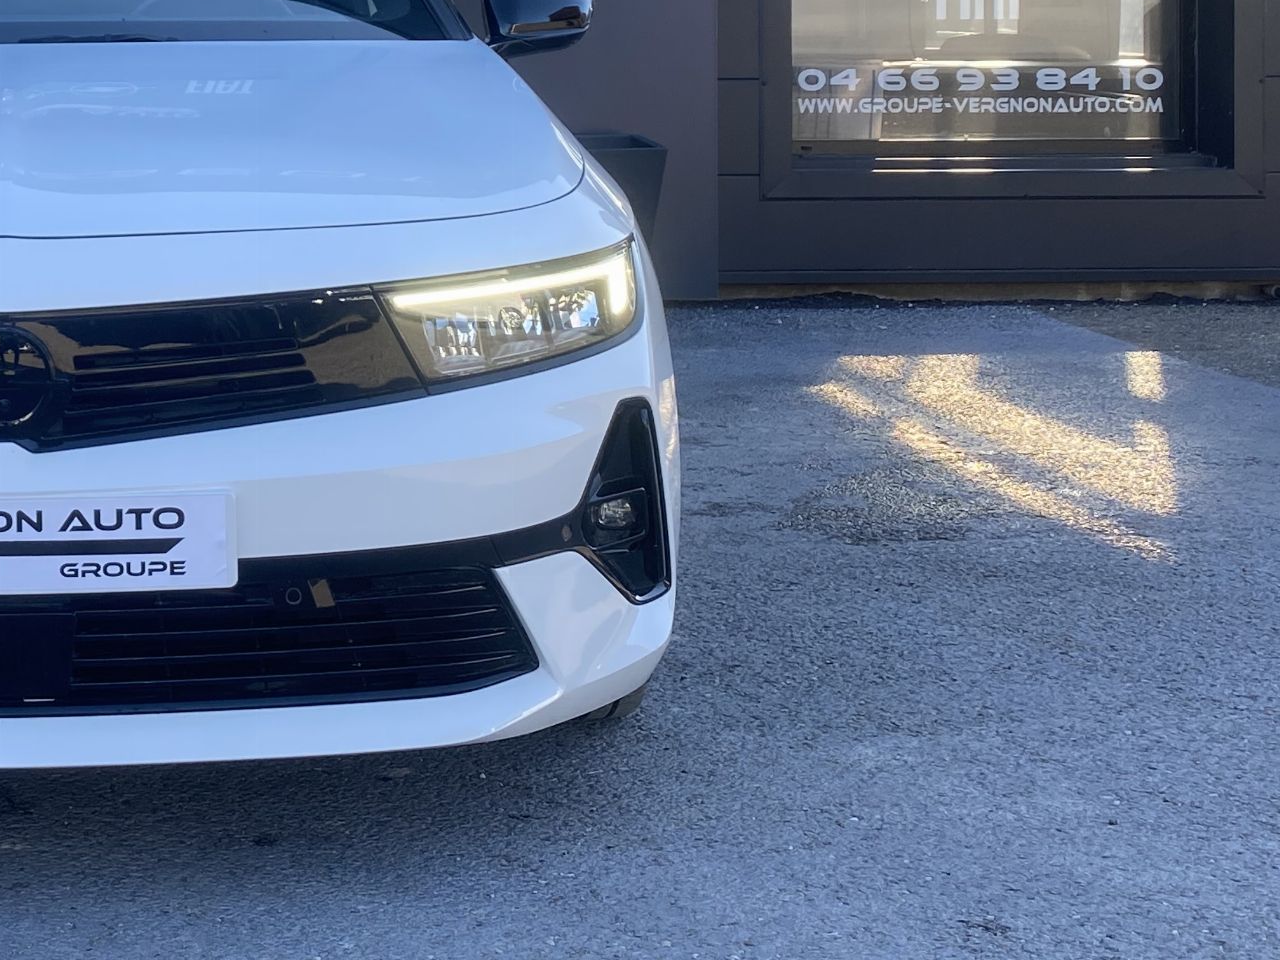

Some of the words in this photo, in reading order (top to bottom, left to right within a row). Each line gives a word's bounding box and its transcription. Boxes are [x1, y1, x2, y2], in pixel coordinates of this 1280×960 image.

[797, 67, 862, 92] 04
[877, 67, 940, 92] 66
[957, 67, 1020, 92] 93
[1035, 67, 1101, 92] 84
[1121, 67, 1164, 92] 10
[797, 96, 1164, 114] WWW.GROUPE-VERGNONAUTO.COM
[57, 506, 186, 533] AUTO
[58, 559, 188, 578] GROUPE
